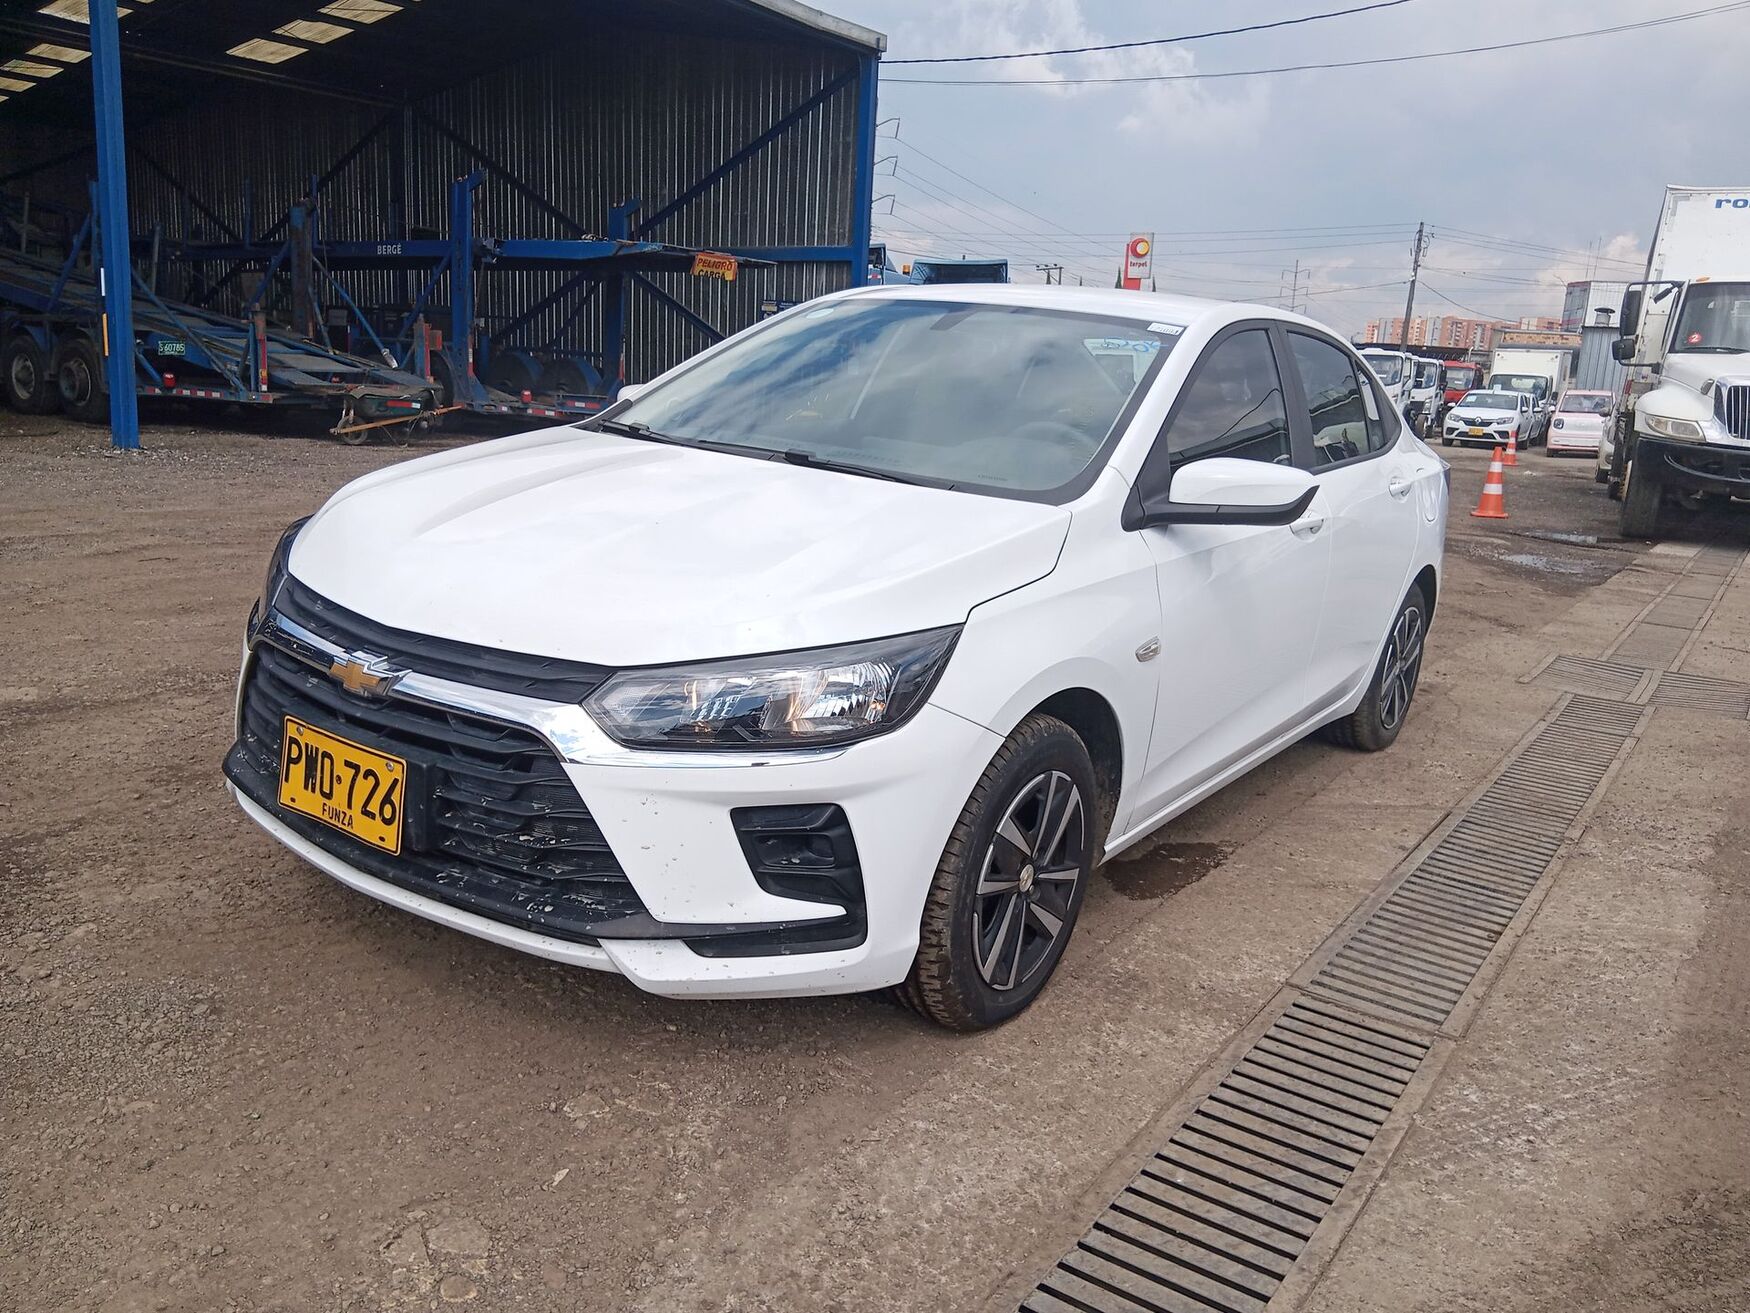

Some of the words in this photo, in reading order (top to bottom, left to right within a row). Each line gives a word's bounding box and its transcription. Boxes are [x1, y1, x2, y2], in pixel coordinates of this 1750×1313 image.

[1715, 198, 1750, 209] ro
[696, 257, 733, 271] PELIGRO
[1129, 260, 1148, 269] terpel
[698, 269, 726, 280] CARGA
[321, 802, 354, 830] FUNZA
